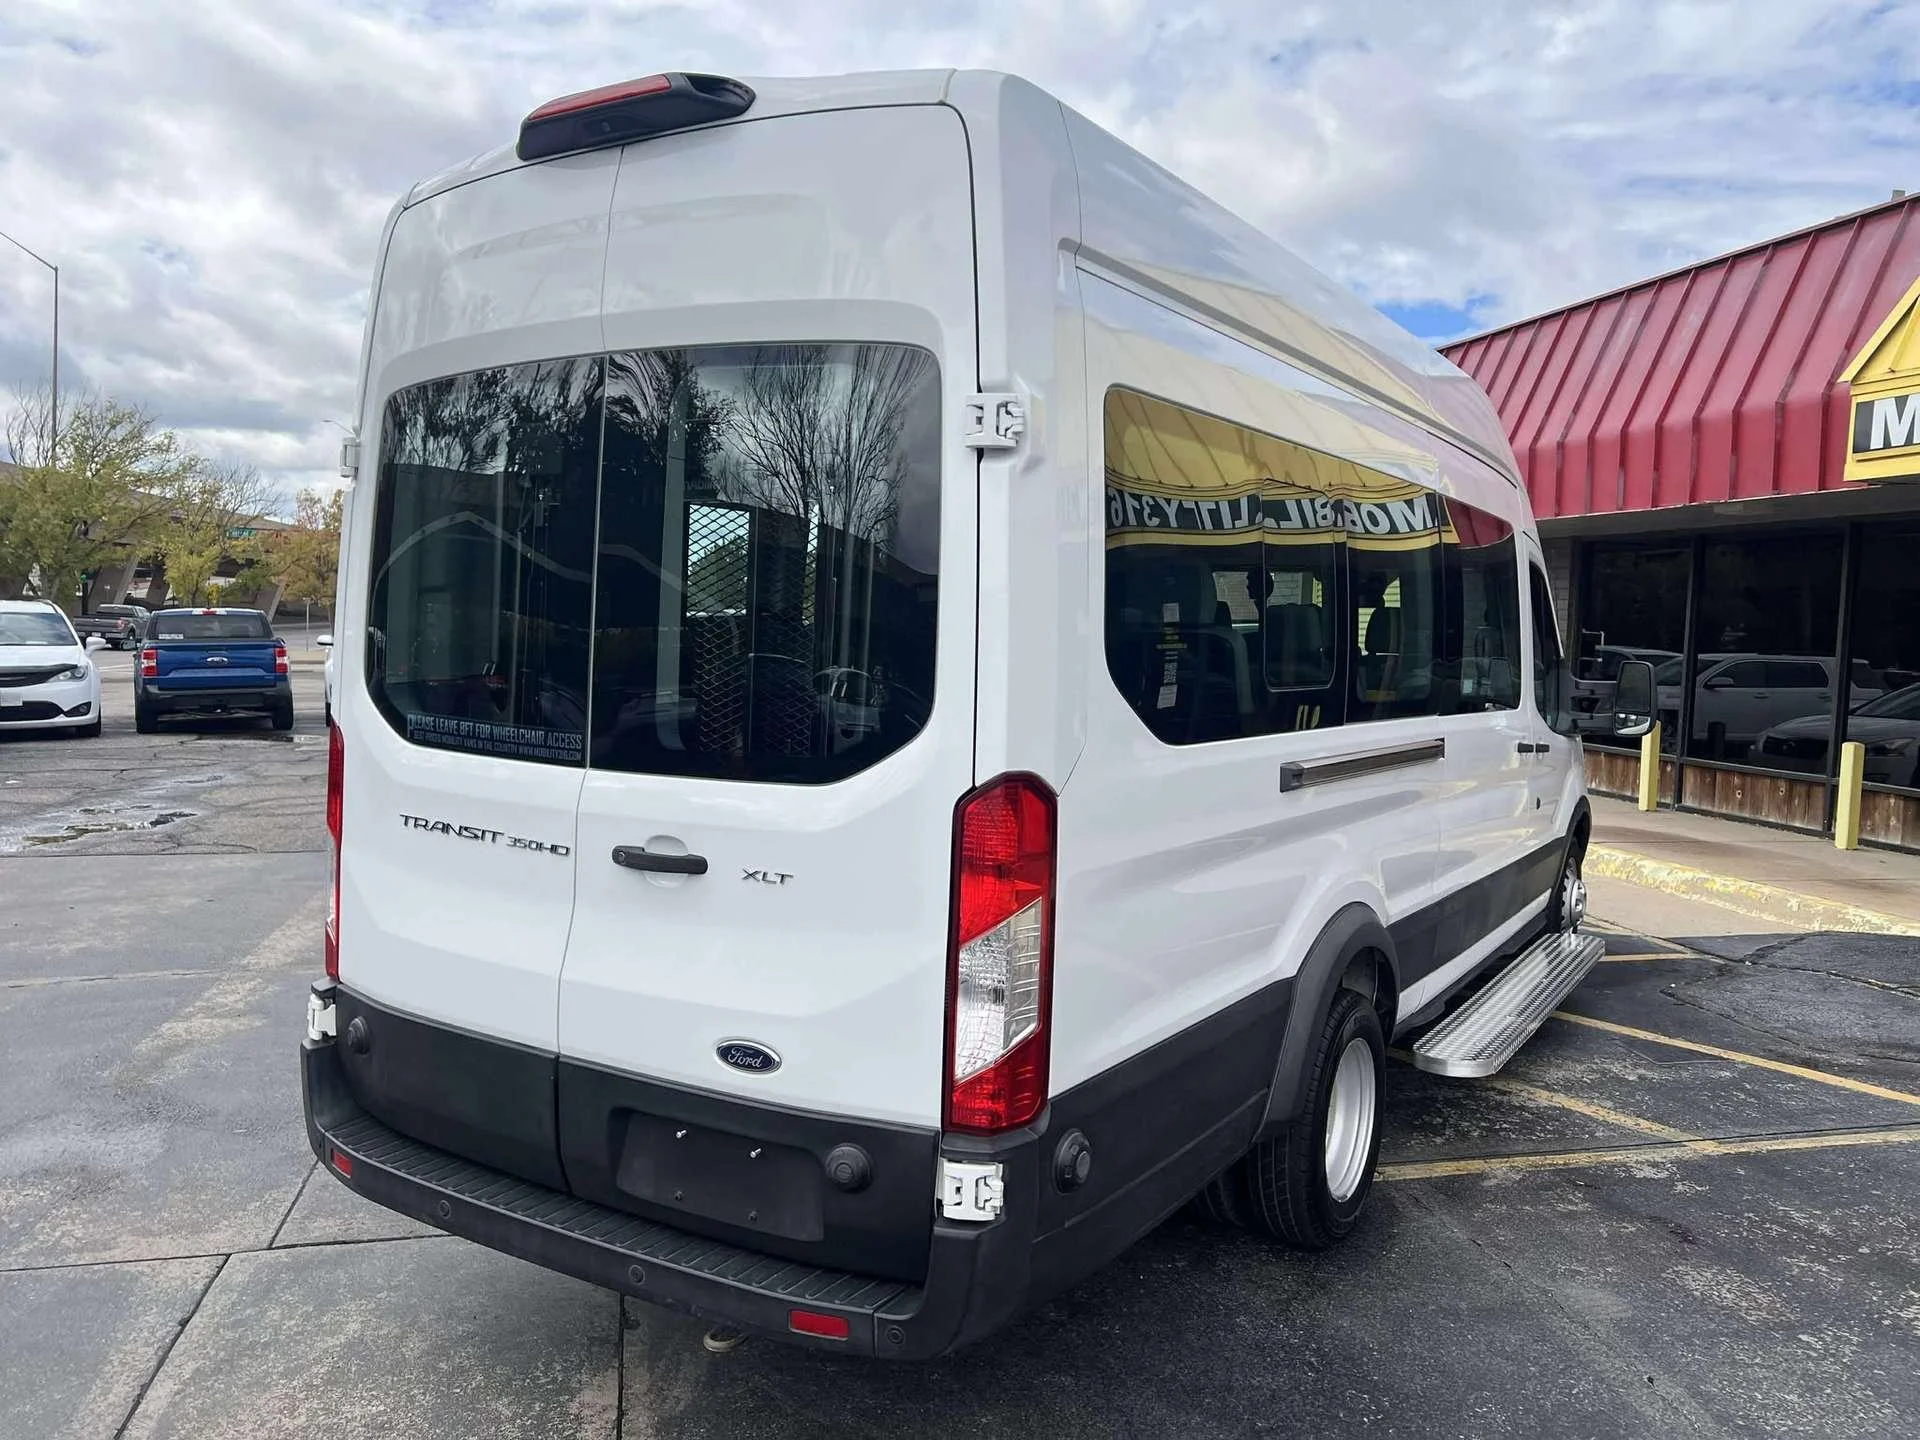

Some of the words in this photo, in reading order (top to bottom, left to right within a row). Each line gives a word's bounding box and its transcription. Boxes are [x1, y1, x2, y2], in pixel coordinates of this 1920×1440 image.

[1870, 392, 1920, 450] M
[407, 713, 435, 735] PLEASE
[436, 717, 458, 735] LEAVE
[476, 723, 491, 739] FOR
[493, 725, 545, 746] WHEELCHAIR
[547, 731, 582, 750] ACCESS
[399, 814, 504, 843] TRANSIT
[506, 836, 571, 856] 350HD
[742, 868, 794, 885] XLT
[728, 1046, 763, 1067] Ford
